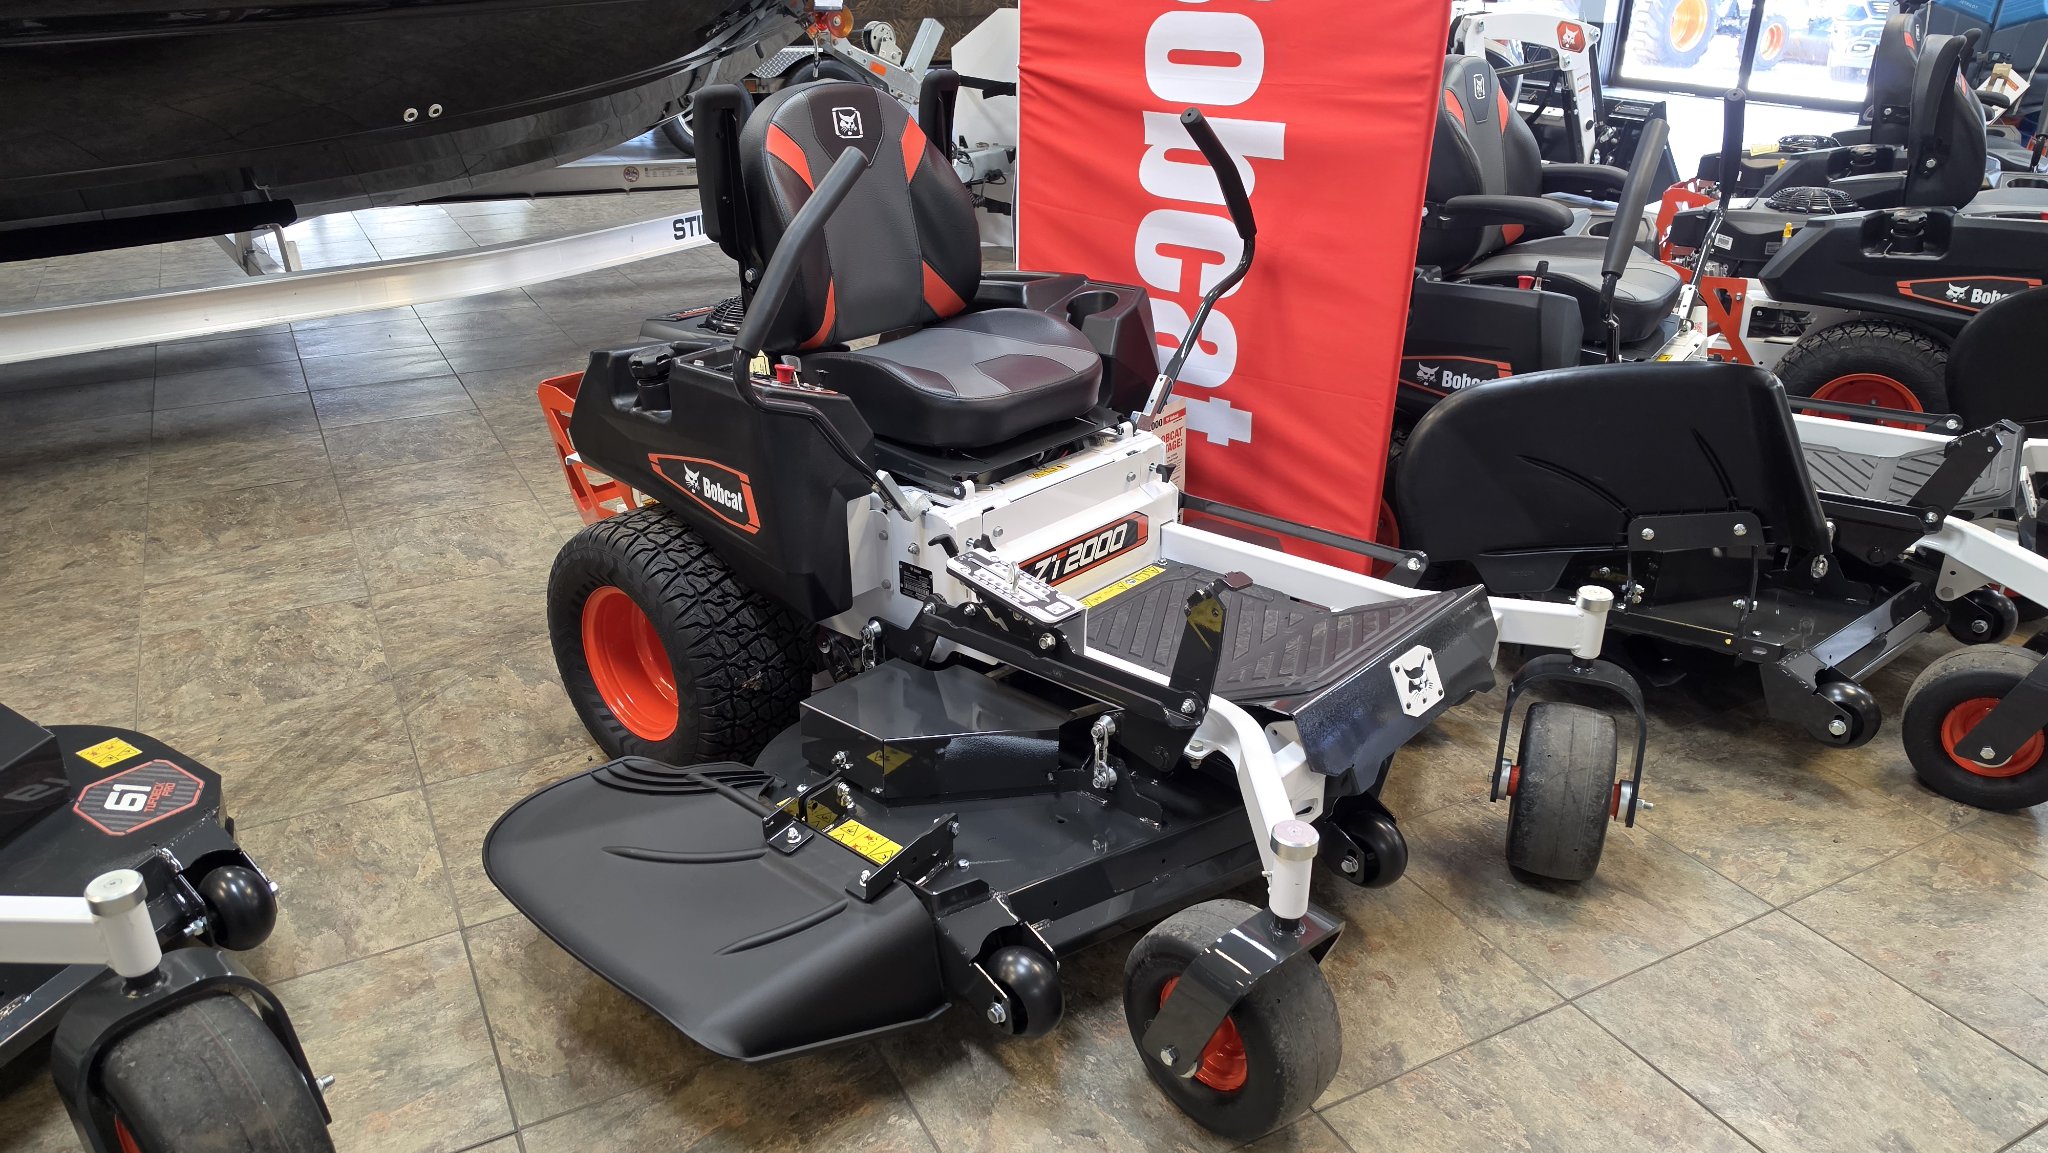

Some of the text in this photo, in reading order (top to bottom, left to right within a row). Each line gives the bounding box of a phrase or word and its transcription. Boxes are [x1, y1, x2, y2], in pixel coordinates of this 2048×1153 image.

[1135, 0, 1286, 447] obcat
[702, 476, 743, 513] Bobcat
[103, 783, 152, 812] 61
